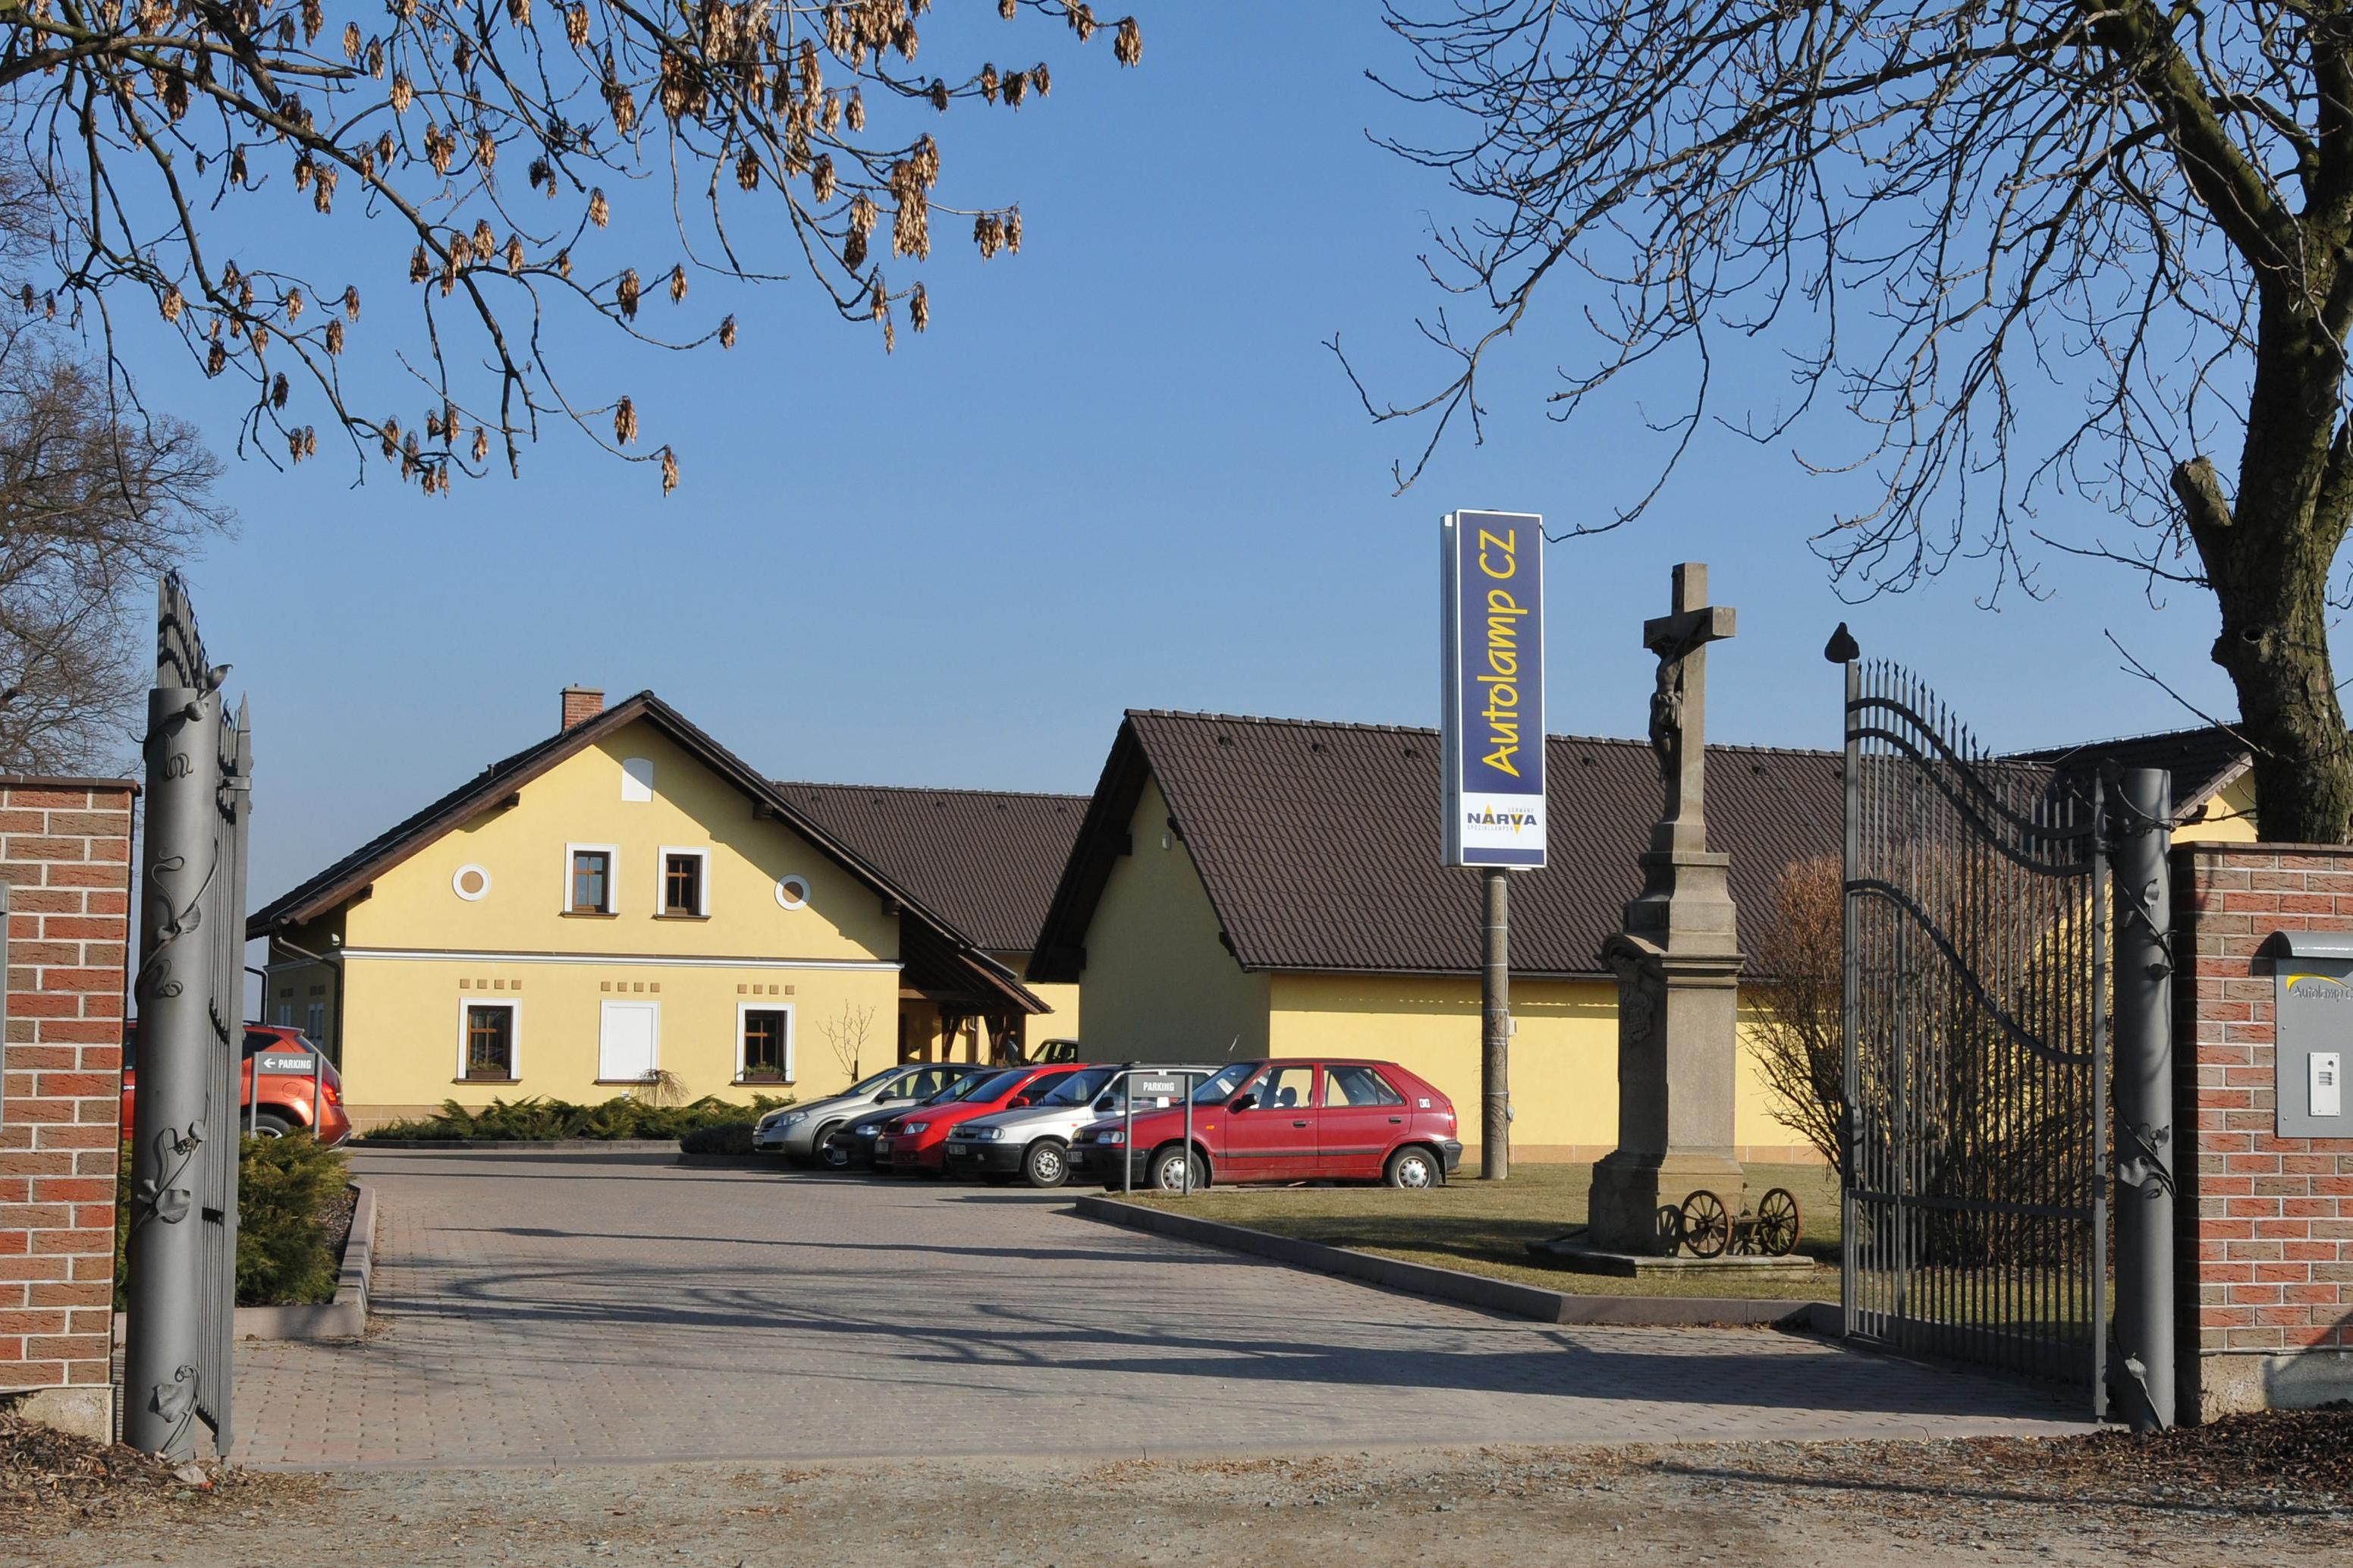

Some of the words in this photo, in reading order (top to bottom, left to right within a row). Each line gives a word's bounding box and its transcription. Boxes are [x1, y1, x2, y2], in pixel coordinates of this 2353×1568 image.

[1479, 529, 1516, 580] CZ
[1477, 589, 1528, 778] Autolamp
[1467, 812, 1538, 825] NARVA
[2293, 984, 2344, 1002] Autolamp
[278, 1059, 312, 1069] PARKING
[1143, 1082, 1175, 1092] PARKING
